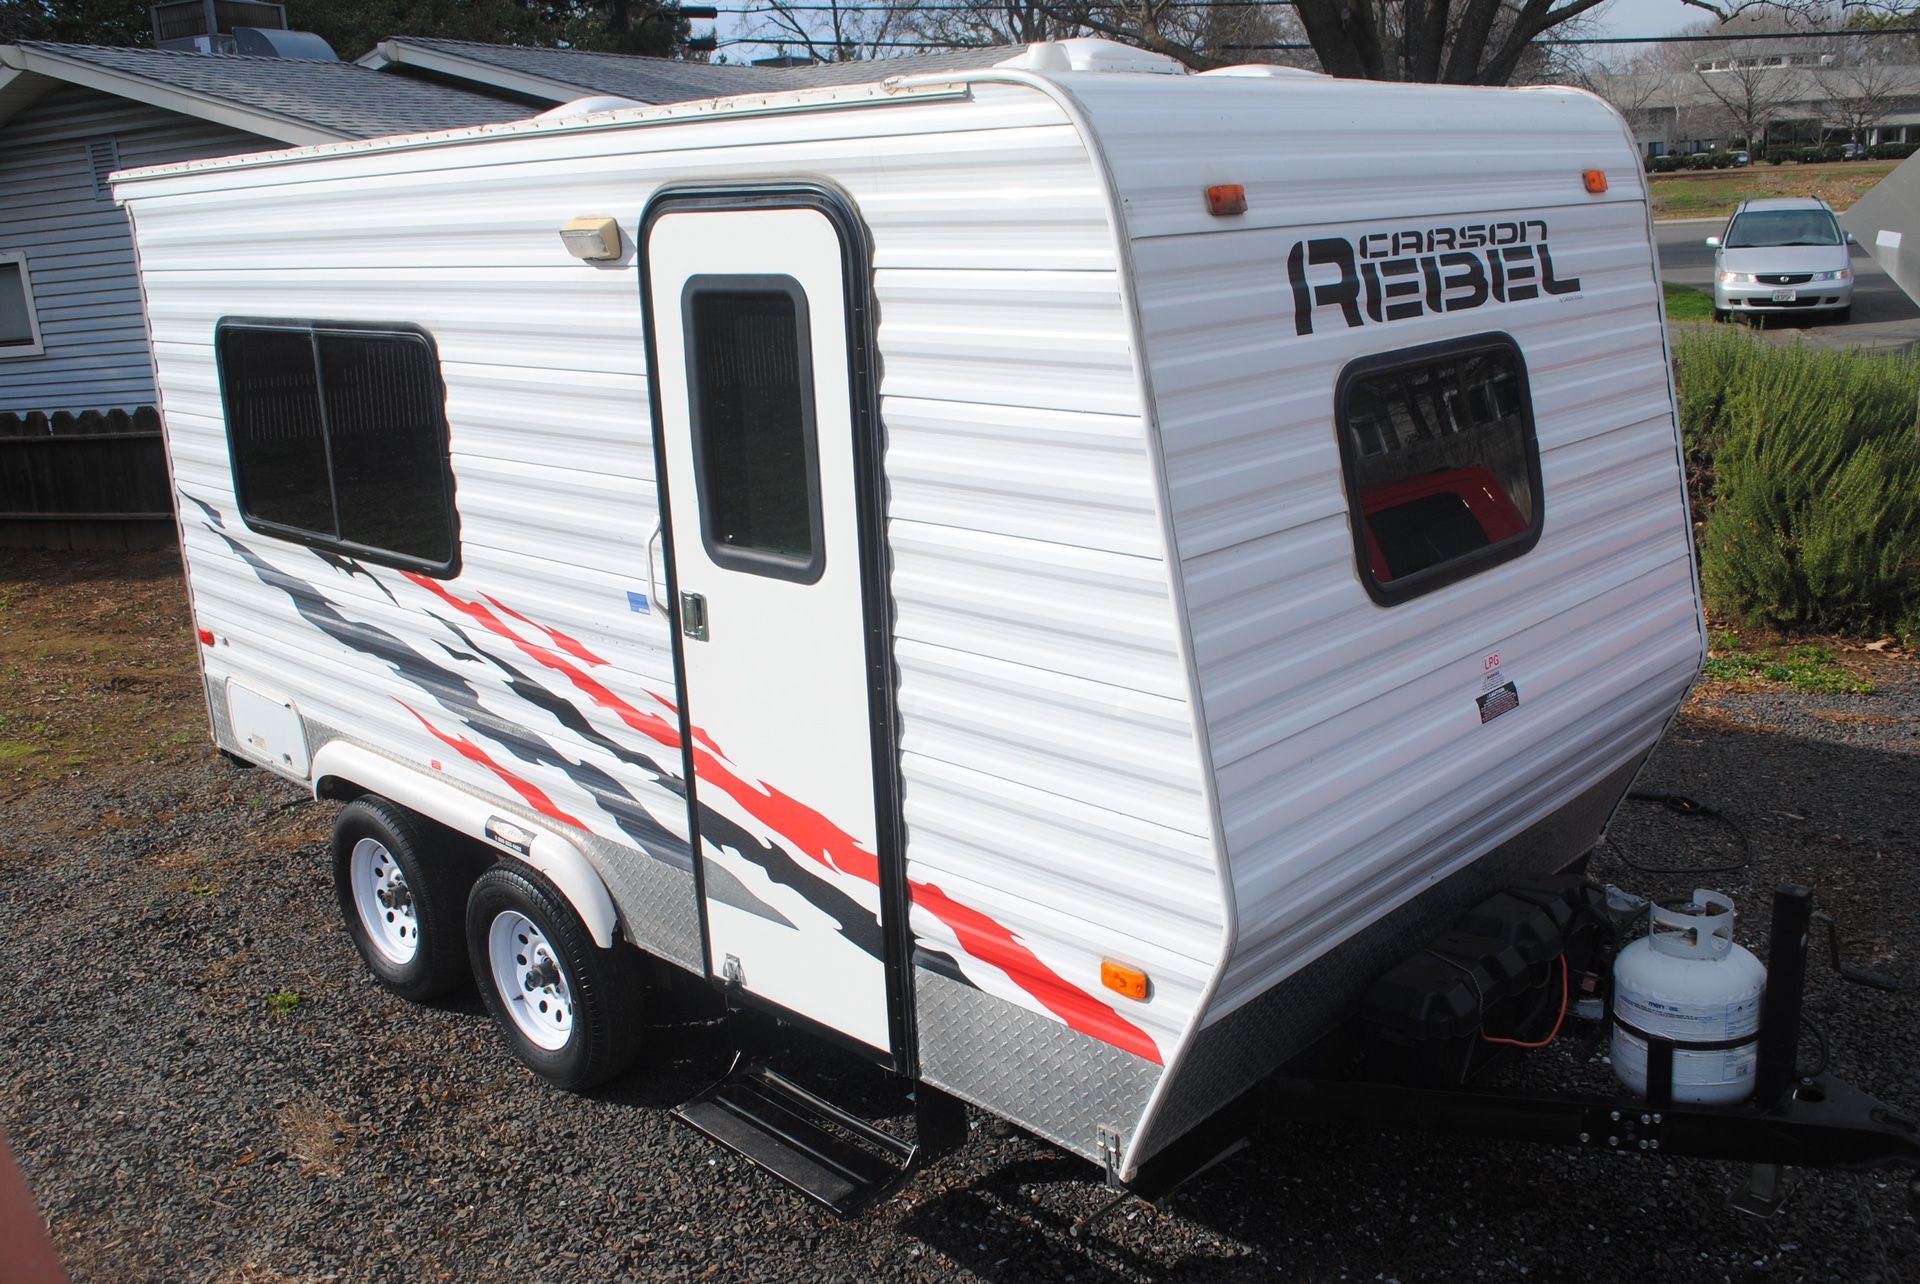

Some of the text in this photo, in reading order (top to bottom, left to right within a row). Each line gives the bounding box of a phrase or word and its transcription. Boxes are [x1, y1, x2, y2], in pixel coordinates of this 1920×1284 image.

[1359, 220, 1548, 259] CARSON
[1287, 237, 1581, 336] REBEL
[1484, 654, 1500, 670] LPG
